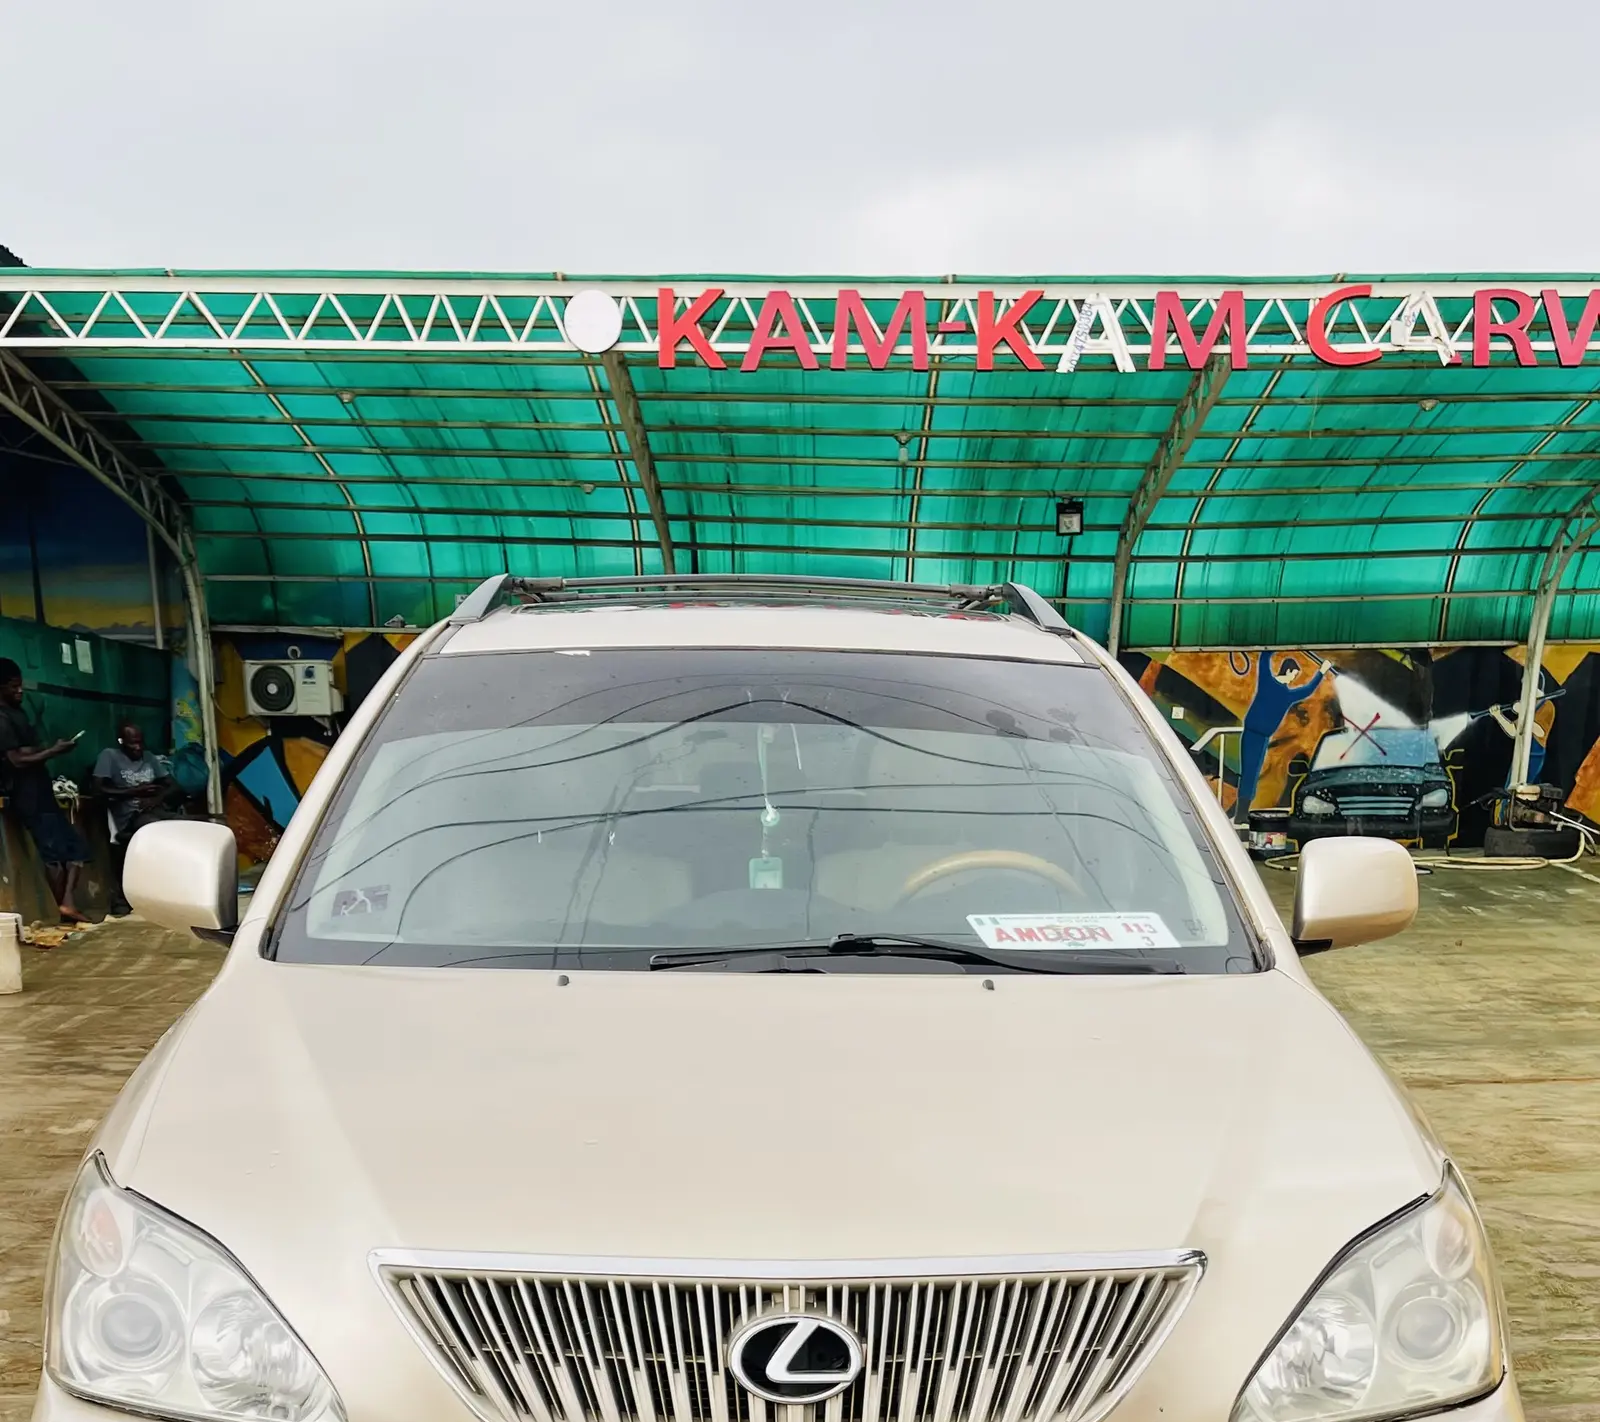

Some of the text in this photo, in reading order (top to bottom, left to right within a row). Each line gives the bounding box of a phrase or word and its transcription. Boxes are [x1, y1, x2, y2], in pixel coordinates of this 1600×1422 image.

[657, 287, 1248, 373] KAM-KAM
[995, 926, 1114, 942] AMDON
[1121, 922, 1158, 934] 113
